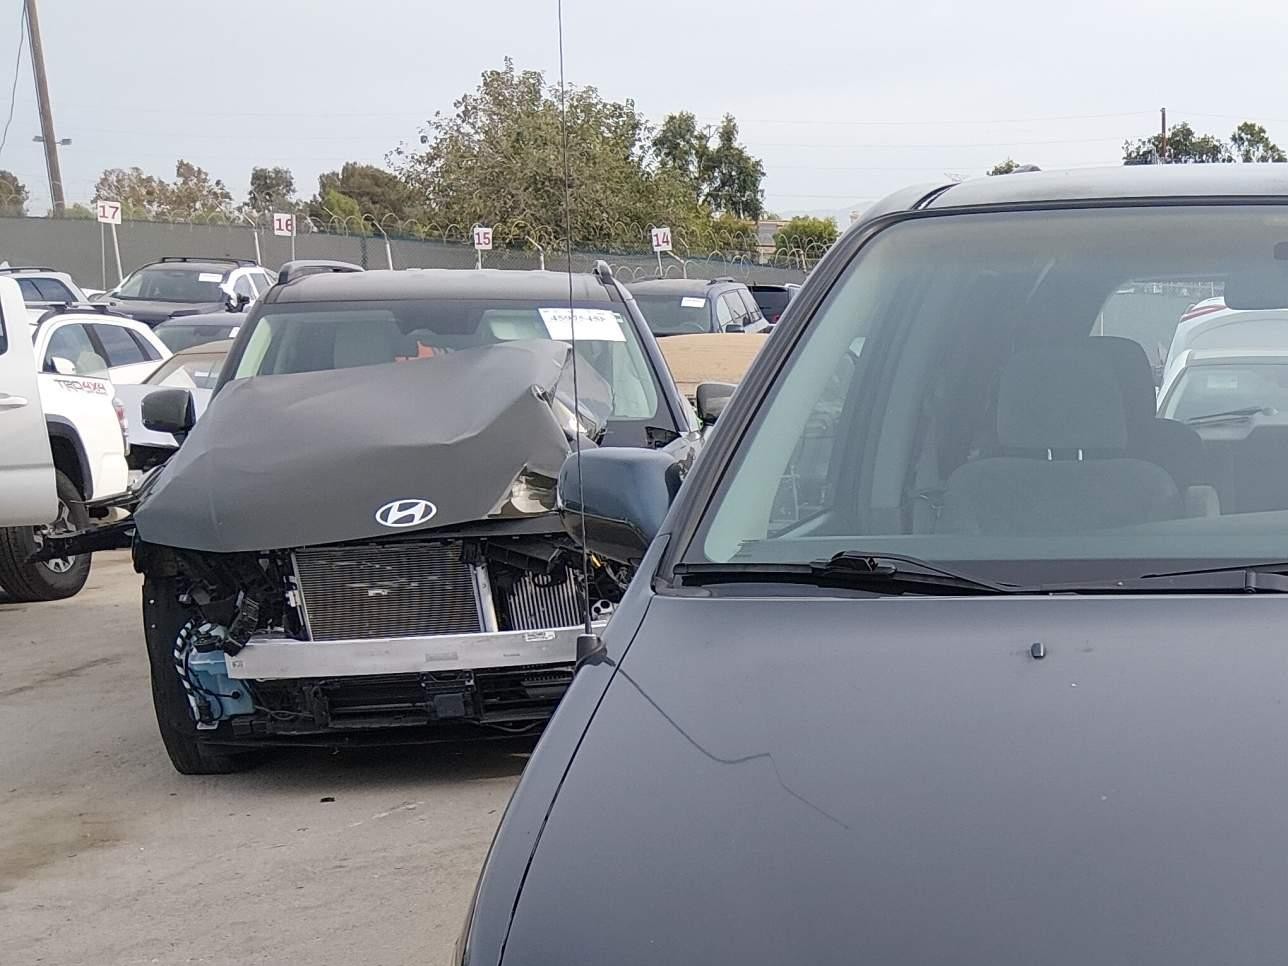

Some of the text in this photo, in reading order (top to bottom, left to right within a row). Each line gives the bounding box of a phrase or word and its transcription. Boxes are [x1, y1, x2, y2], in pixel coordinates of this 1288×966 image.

[98, 204, 119, 220] 17
[275, 218, 292, 232] 16
[475, 231, 491, 246] 15
[654, 231, 670, 248] 14
